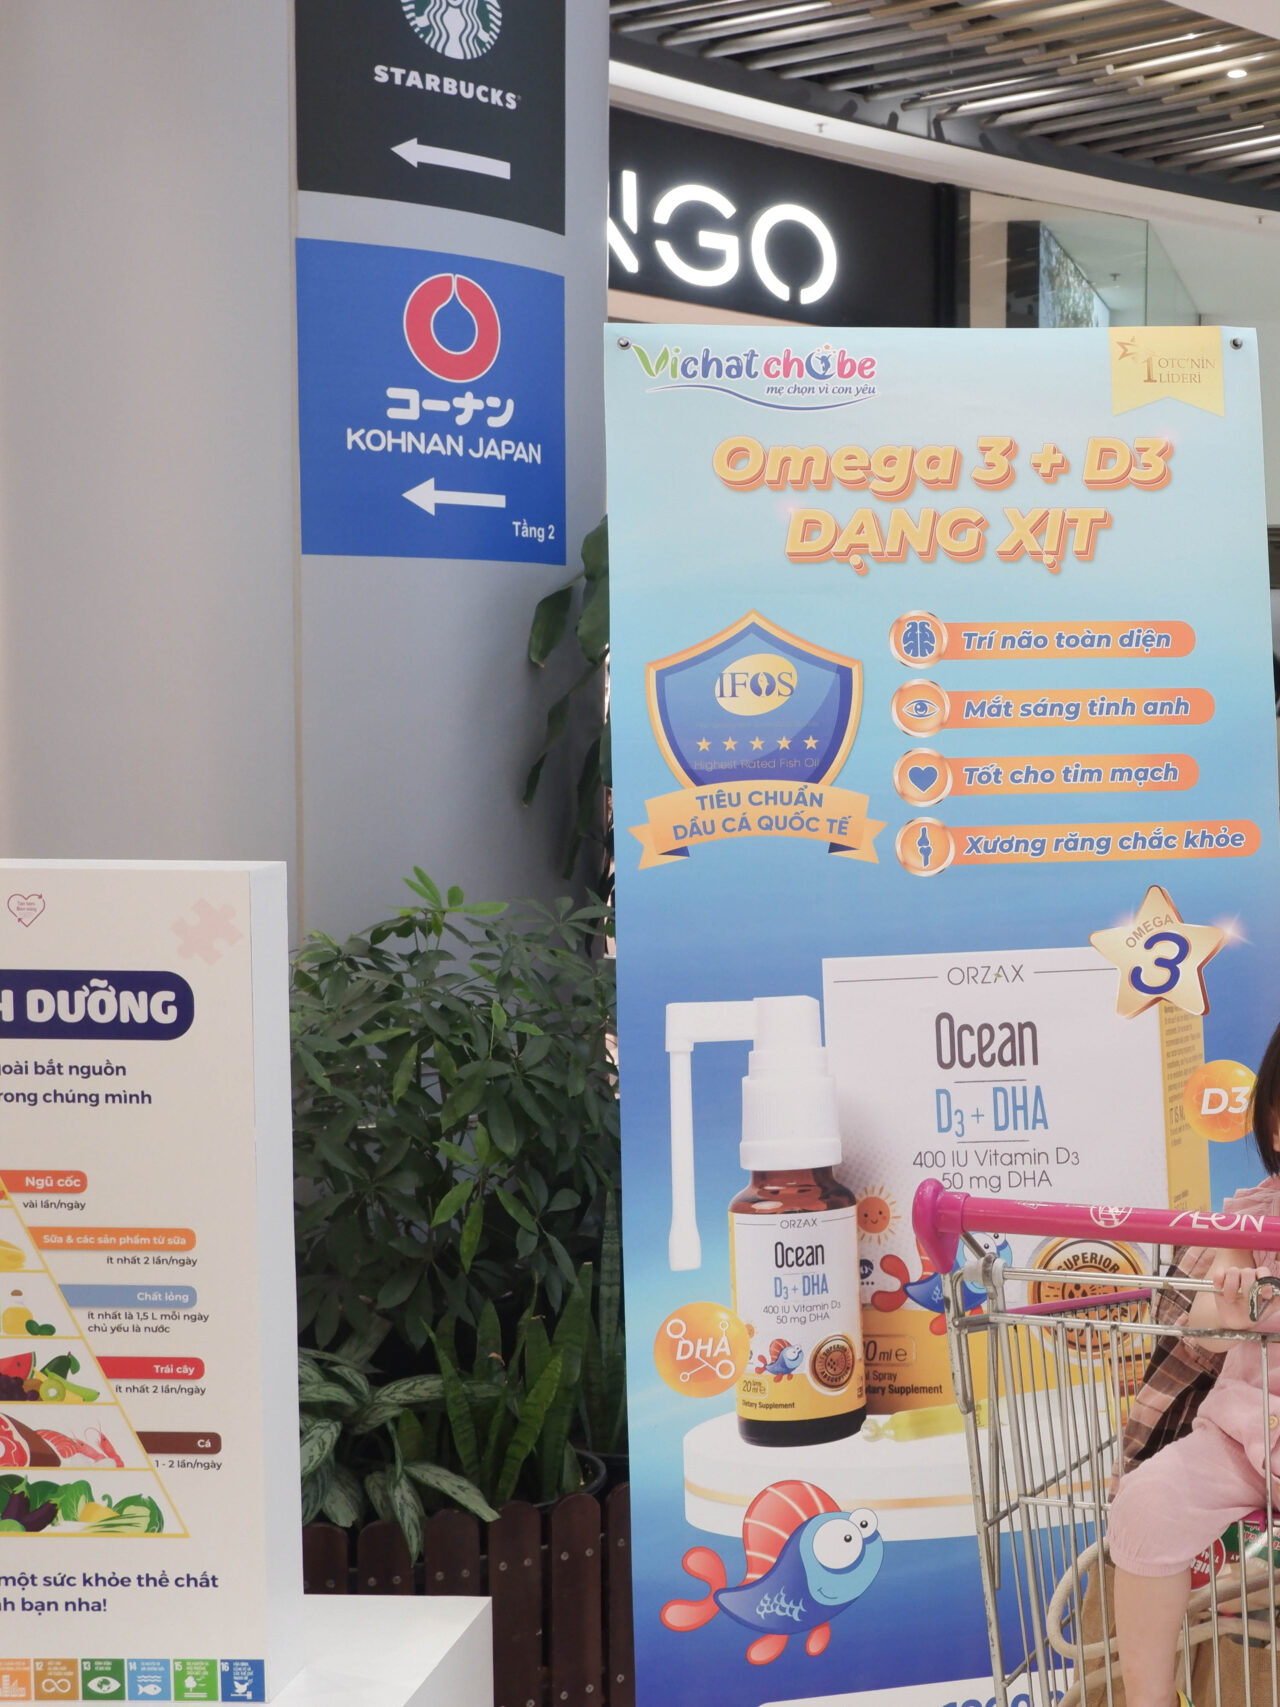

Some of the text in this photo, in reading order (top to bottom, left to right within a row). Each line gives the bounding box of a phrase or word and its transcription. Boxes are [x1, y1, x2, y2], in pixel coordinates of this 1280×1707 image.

[373, 64, 517, 110] STARBUCKS
[766, 383, 876, 396] mẹ chọn vì con yêu
[386, 387, 514, 427] コーナン
[347, 428, 541, 464] KOHNAN JAPAN
[712, 436, 962, 500] Omega
[970, 436, 1018, 490] 3
[1082, 436, 1174, 491] D3
[512, 521, 555, 541] Tầng 2
[785, 507, 1112, 575] DẠNG XỊT
[963, 628, 1171, 653] Trí não toàn diện
[716, 672, 795, 698] IFOS
[964, 696, 1190, 721] Mắt sáng tinh anh
[694, 757, 819, 772] Highest Rated Fish Oil
[964, 763, 1179, 787] Tốt cho tim mạch
[696, 785, 824, 811] TIÊU CHUẨN
[672, 810, 852, 840] DẦU CÁ QUỐC TẾ
[964, 826, 1246, 857] Xương răng chắc khỏe
[1125, 914, 1175, 948] OMEGA
[1130, 932, 1190, 995] 3
[947, 964, 1024, 986] ORZAX
[26, 978, 178, 1024] DƯỠNG
[935, 1012, 1039, 1070] Ocean
[0, 1059, 126, 1080] oài bắt nguồn
[43, 1088, 99, 1107] chúng
[104, 1089, 152, 1104] mình
[1201, 1086, 1250, 1115] D3
[993, 1085, 1048, 1132] DHA
[912, 1147, 1080, 1168] 400 IU Vitamin D3
[25, 1175, 81, 1190] Ngũ cốc
[941, 1170, 1053, 1194] 50 mg DHA
[22, 1199, 86, 1211] vài lần/ngày
[780, 1218, 818, 1229] ORZAX
[43, 1234, 187, 1246] Sữa & các sản phẩm từ sữa
[106, 1255, 198, 1267] ít nhất 2 lần/ngày
[774, 1241, 825, 1269] Ocean
[802, 1273, 829, 1296] DHA
[137, 1291, 189, 1303] Chất lỏng
[87, 1309, 209, 1323] ít nhất là 1,5 L mỗi ngày
[763, 1304, 779, 1315] 400
[781, 1303, 791, 1314] IU
[792, 1302, 829, 1314] Vitamin
[776, 1312, 830, 1326] 50 mg DHA
[87, 1323, 170, 1335] chủ yếu là nước
[676, 1335, 731, 1361] DHA
[879, 1349, 892, 1361] ml
[153, 1364, 195, 1376] Trái cây
[873, 1371, 897, 1386] Spray
[115, 1384, 206, 1396] ít nhất 2 lần/ngày
[742, 1380, 752, 1393] 20
[889, 1384, 943, 1395] Supplement
[758, 1401, 795, 1410] Supplement
[197, 1438, 212, 1448] Cá
[169, 1459, 223, 1470] 2 lần/ngày
[0, 1570, 219, 1591] một sức khỏe thể chất
[21, 1597, 107, 1616] bạn nha!
